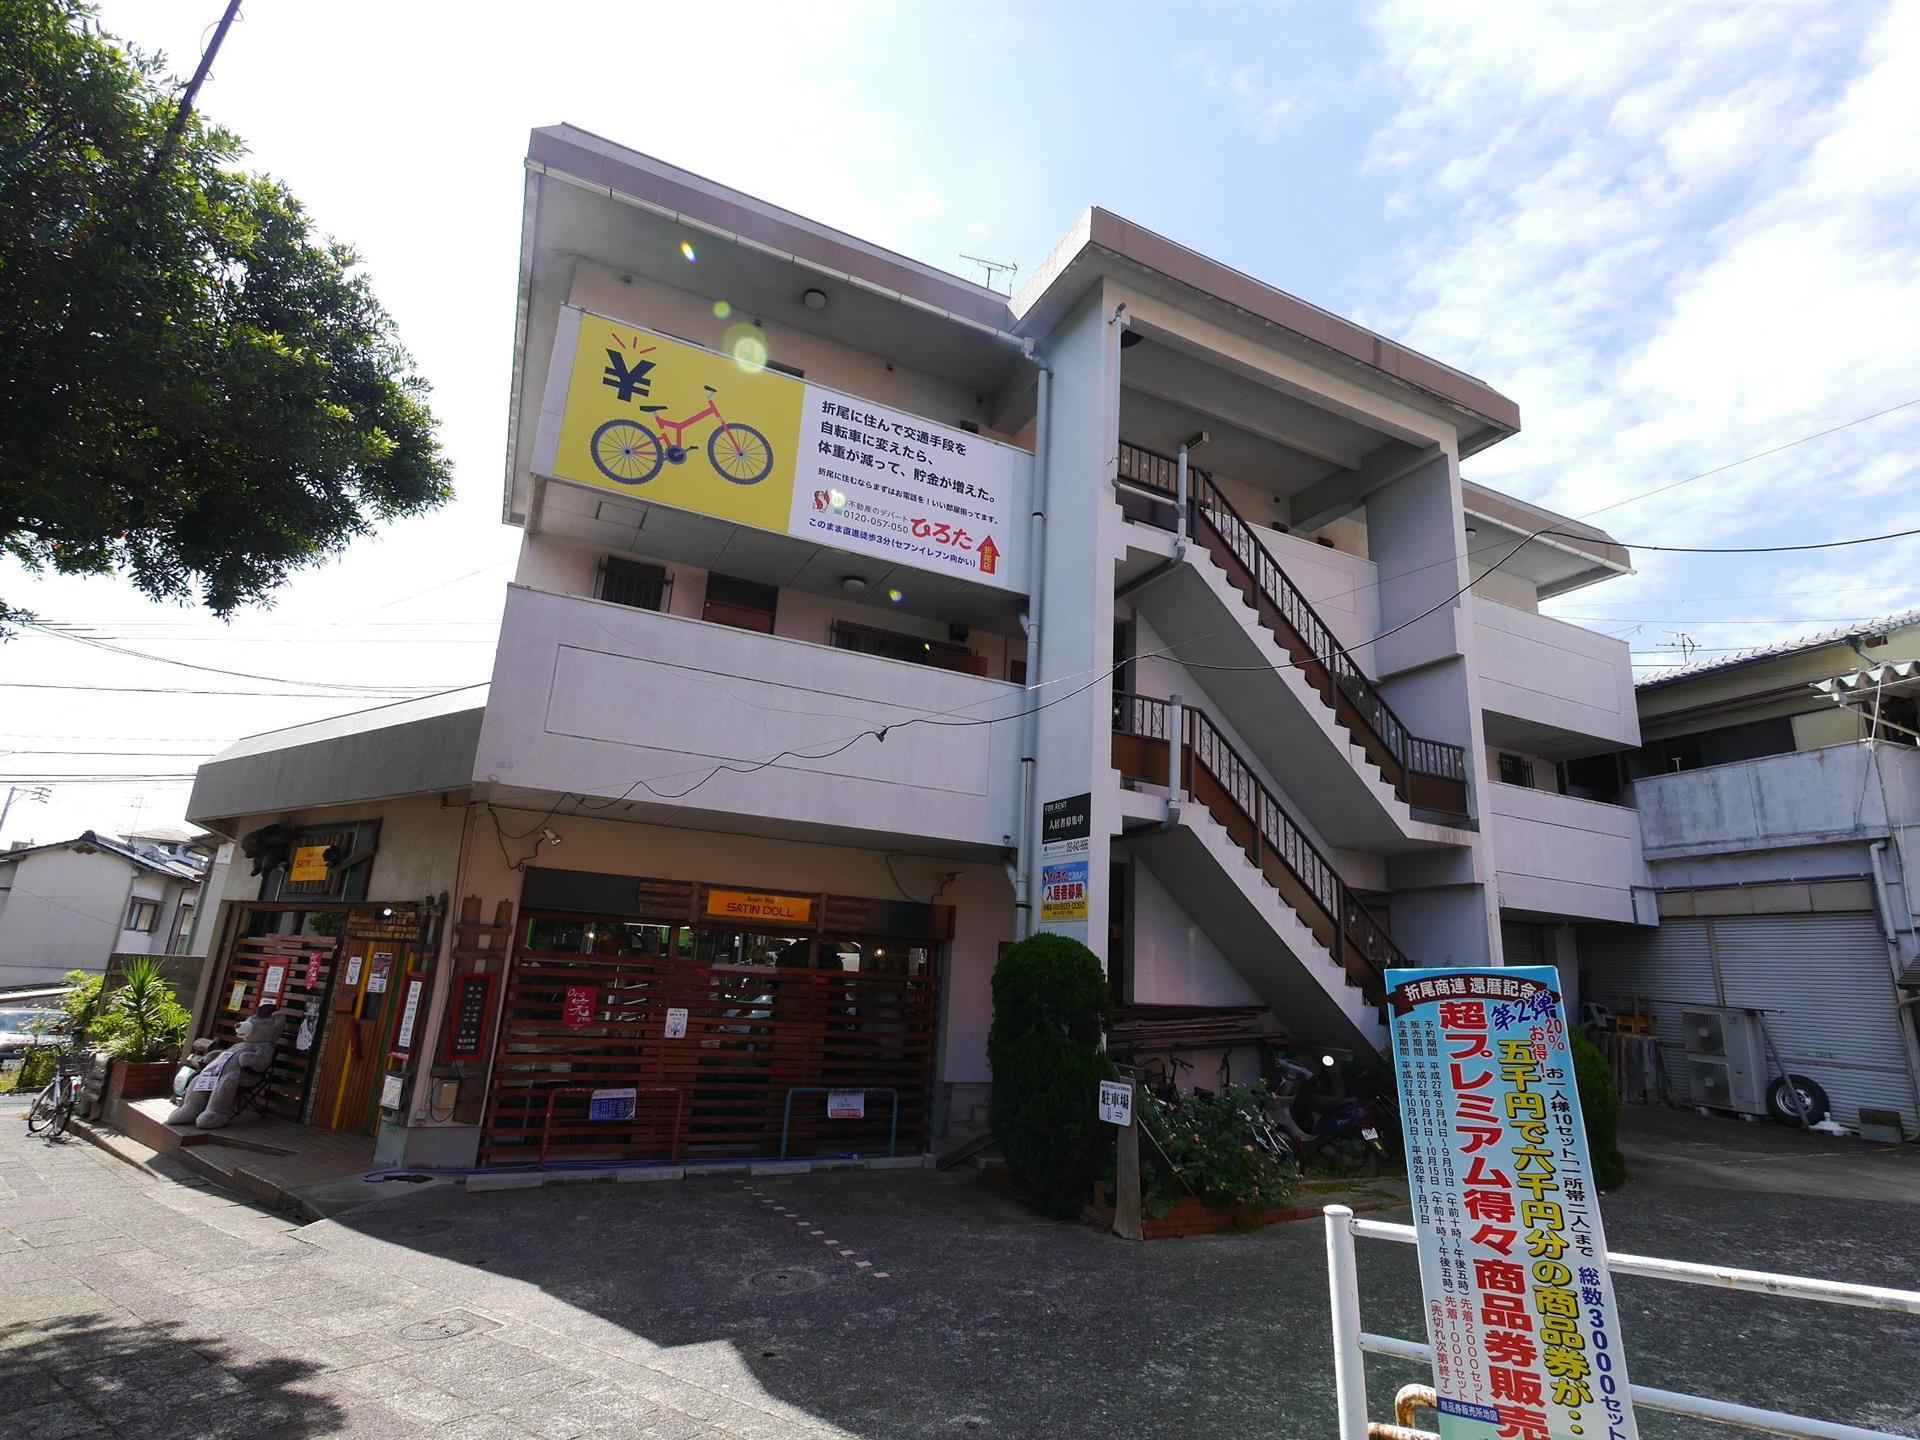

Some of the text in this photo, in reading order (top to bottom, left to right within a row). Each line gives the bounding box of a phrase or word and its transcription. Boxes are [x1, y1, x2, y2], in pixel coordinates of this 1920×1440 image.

[820, 420, 935, 466] 自転車に変えたら、
[821, 400, 967, 456] 折尾に住んで交通手段を
[818, 440, 995, 503] 体重が減って、貯金が増えた。
[843, 510, 909, 534] 0120-057-050
[910, 517, 973, 551] ひろた
[1044, 800, 1068, 813] FOR RENT
[1048, 813, 1084, 831] 入居者募集中
[1046, 883, 1083, 901] 入居者募集
[726, 902, 794, 917] SATIN DOLL
[1404, 977, 1539, 1002] 折尾商連 還暦記念
[1490, 990, 1557, 1032] 第2弾
[1410, 1020, 1424, 1056] 販売期間
[1424, 1020, 1438, 1057] 予約期間
[1545, 1018, 1566, 1051] 20%
[1101, 1090, 1129, 1110] 駐車場
